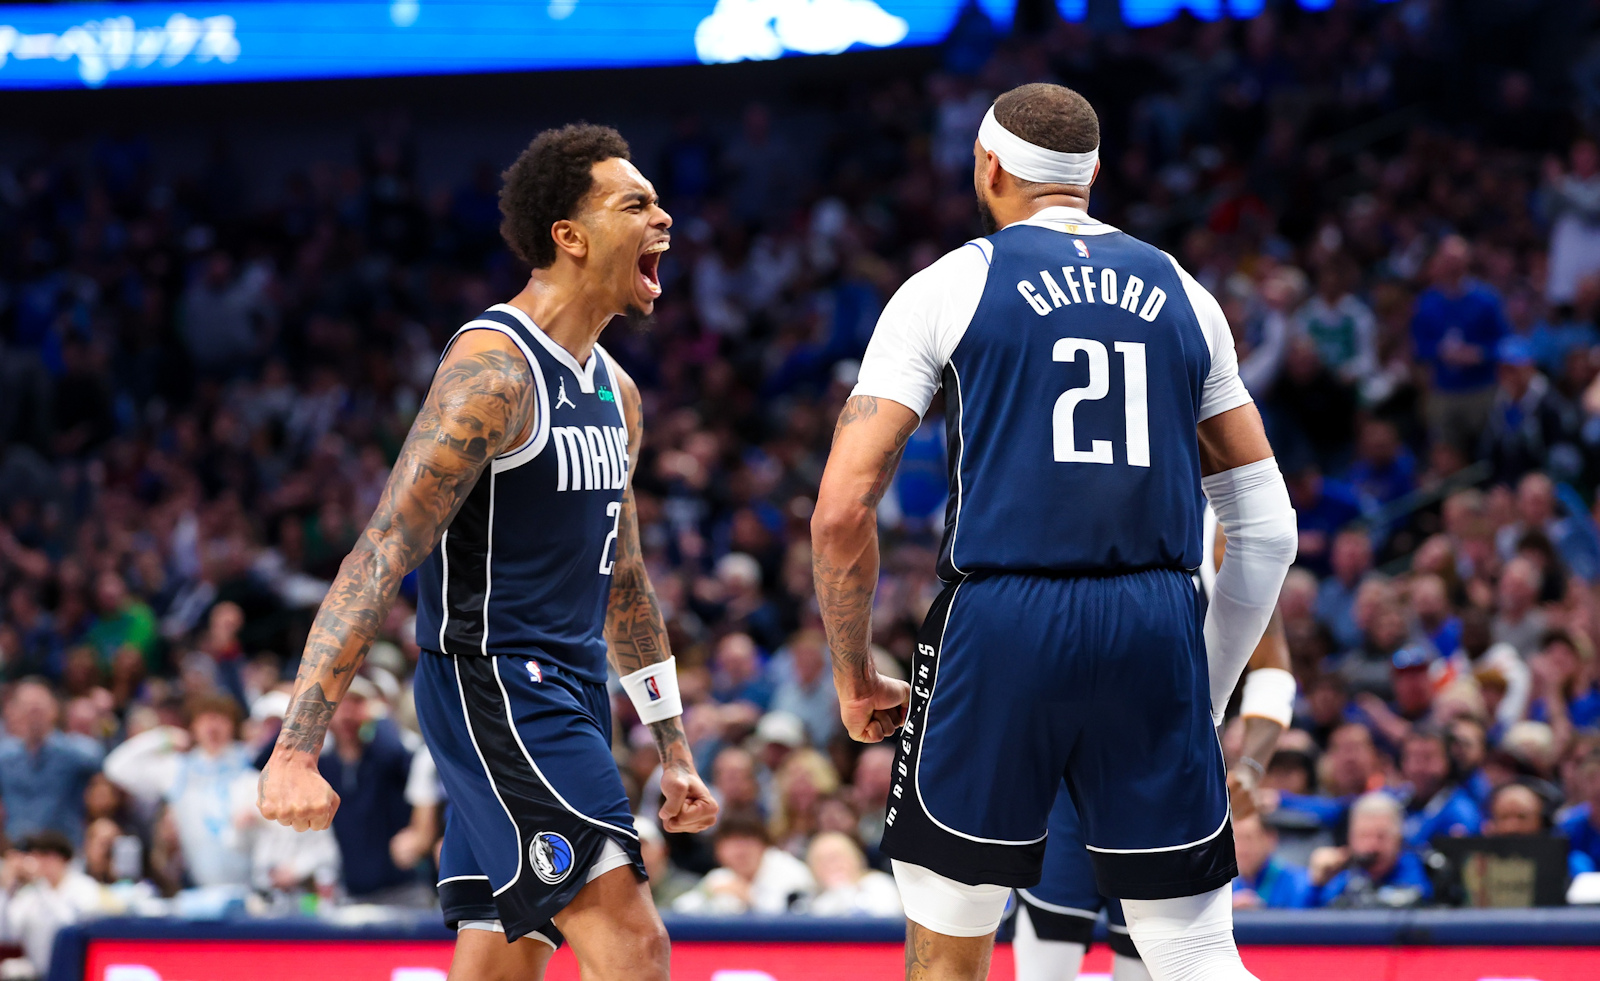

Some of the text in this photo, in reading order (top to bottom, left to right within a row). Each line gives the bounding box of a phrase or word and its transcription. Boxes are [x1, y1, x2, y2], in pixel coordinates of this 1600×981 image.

[1016, 265, 1167, 323] GAFFORD
[1052, 337, 1151, 467] 21
[599, 501, 622, 575] 2
